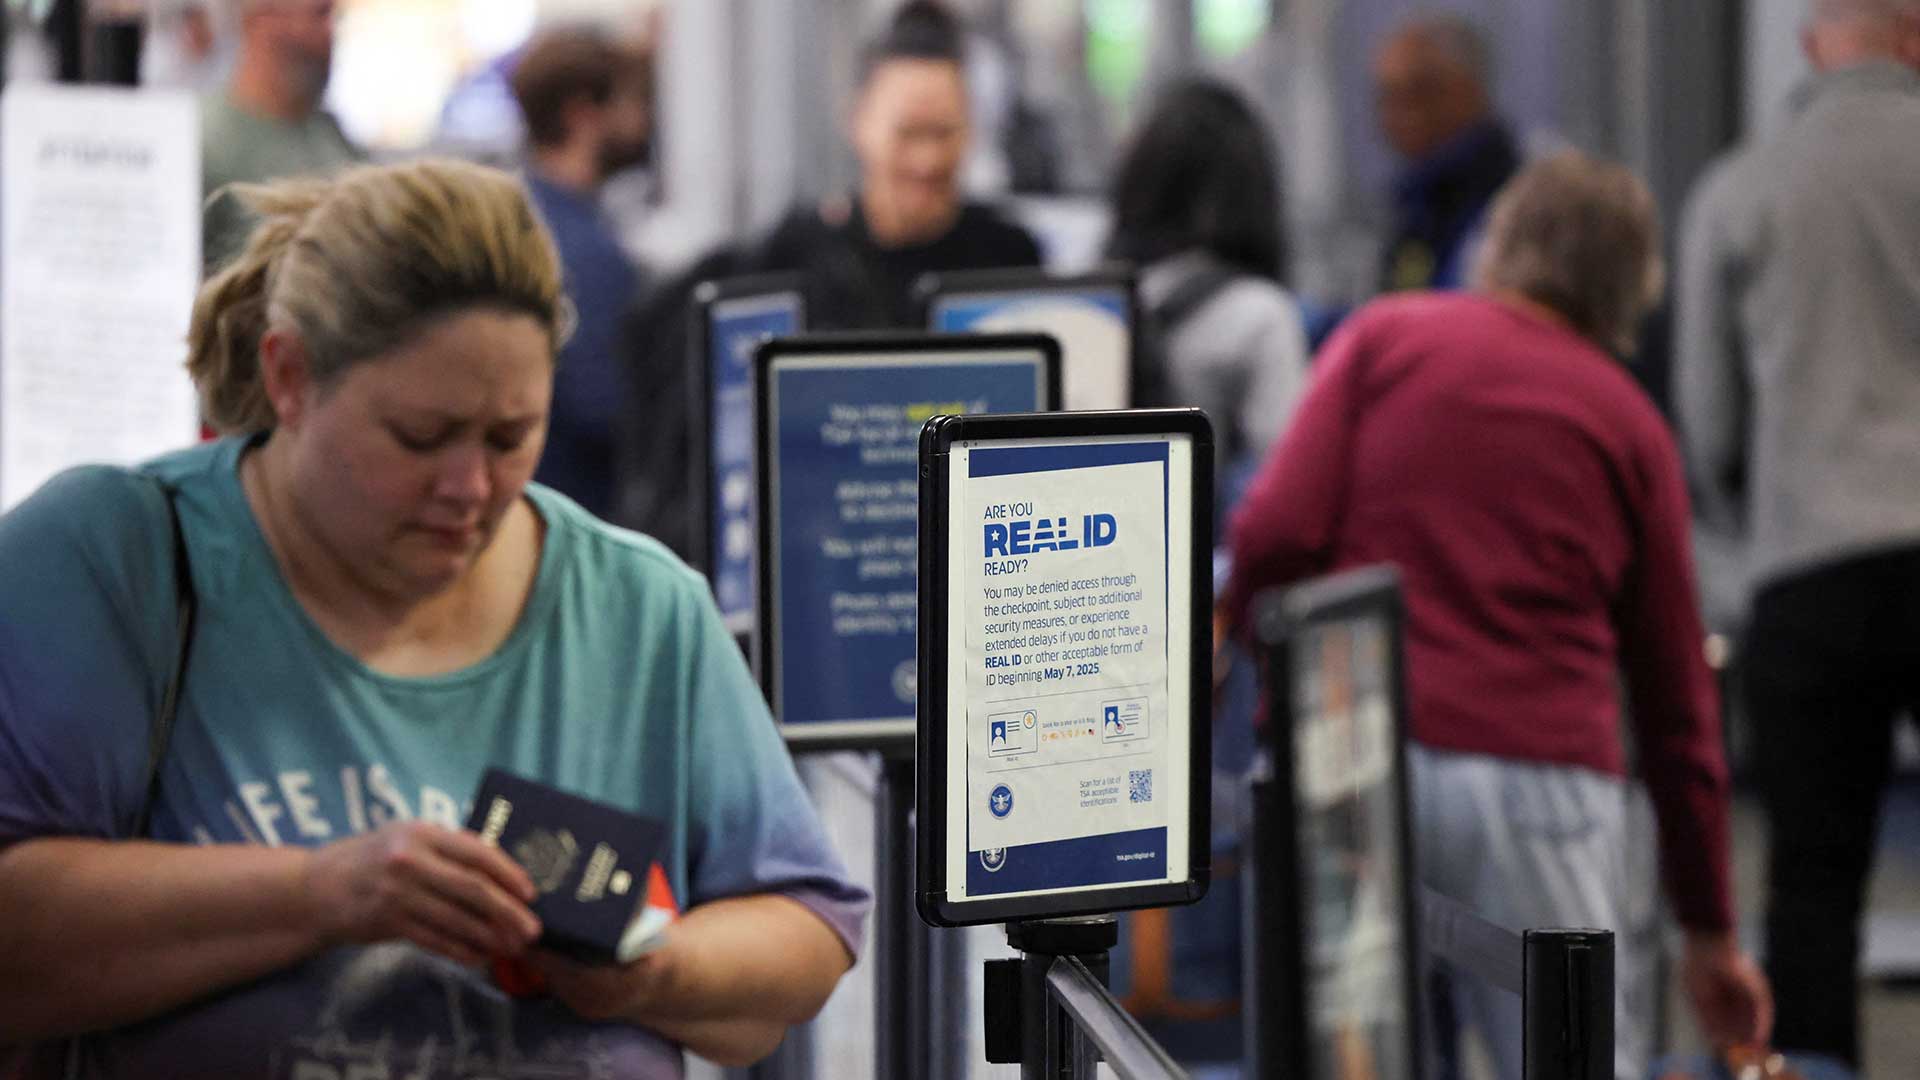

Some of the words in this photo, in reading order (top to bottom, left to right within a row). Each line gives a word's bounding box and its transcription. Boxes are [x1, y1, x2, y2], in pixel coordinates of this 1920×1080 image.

[984, 504, 1006, 519] ARE
[1008, 502, 1033, 517] YOU
[984, 517, 1079, 558] REAL
[1083, 513, 1117, 548] ID
[984, 558, 1029, 576] READY?
[984, 587, 1001, 599] You
[1004, 586, 1024, 599] may
[1026, 583, 1037, 595] be
[1039, 580, 1069, 594] denied
[1071, 577, 1099, 590] access
[1101, 573, 1137, 588] through
[984, 605, 1000, 617] the
[1001, 599, 1051, 616] checkpoint,
[1053, 597, 1086, 612] subject
[1088, 595, 1097, 606] to
[1099, 589, 1143, 605] additional
[984, 621, 1021, 634] security
[1022, 616, 1067, 631] measures,
[1069, 615, 1079, 625] or
[1081, 609, 1130, 625] experience
[985, 637, 1027, 651] extended
[1028, 633, 1058, 649] delays
[1060, 631, 1067, 643] if
[1069, 630, 1086, 645] you
[1087, 628, 1100, 640] do
[1102, 626, 1117, 639] not
[1118, 624, 1141, 637] have
[1142, 624, 1148, 635] a
[985, 655, 1010, 668] REAL
[1012, 653, 1022, 666] ID
[1023, 654, 1033, 665] or
[1035, 650, 1060, 664] other
[1062, 644, 1109, 662] acceptable
[1110, 641, 1132, 655] form
[1134, 640, 1144, 652] of
[986, 674, 996, 686] ID
[998, 669, 1043, 687] beginning
[1044, 667, 1065, 681] May
[1066, 665, 1075, 677] 7,
